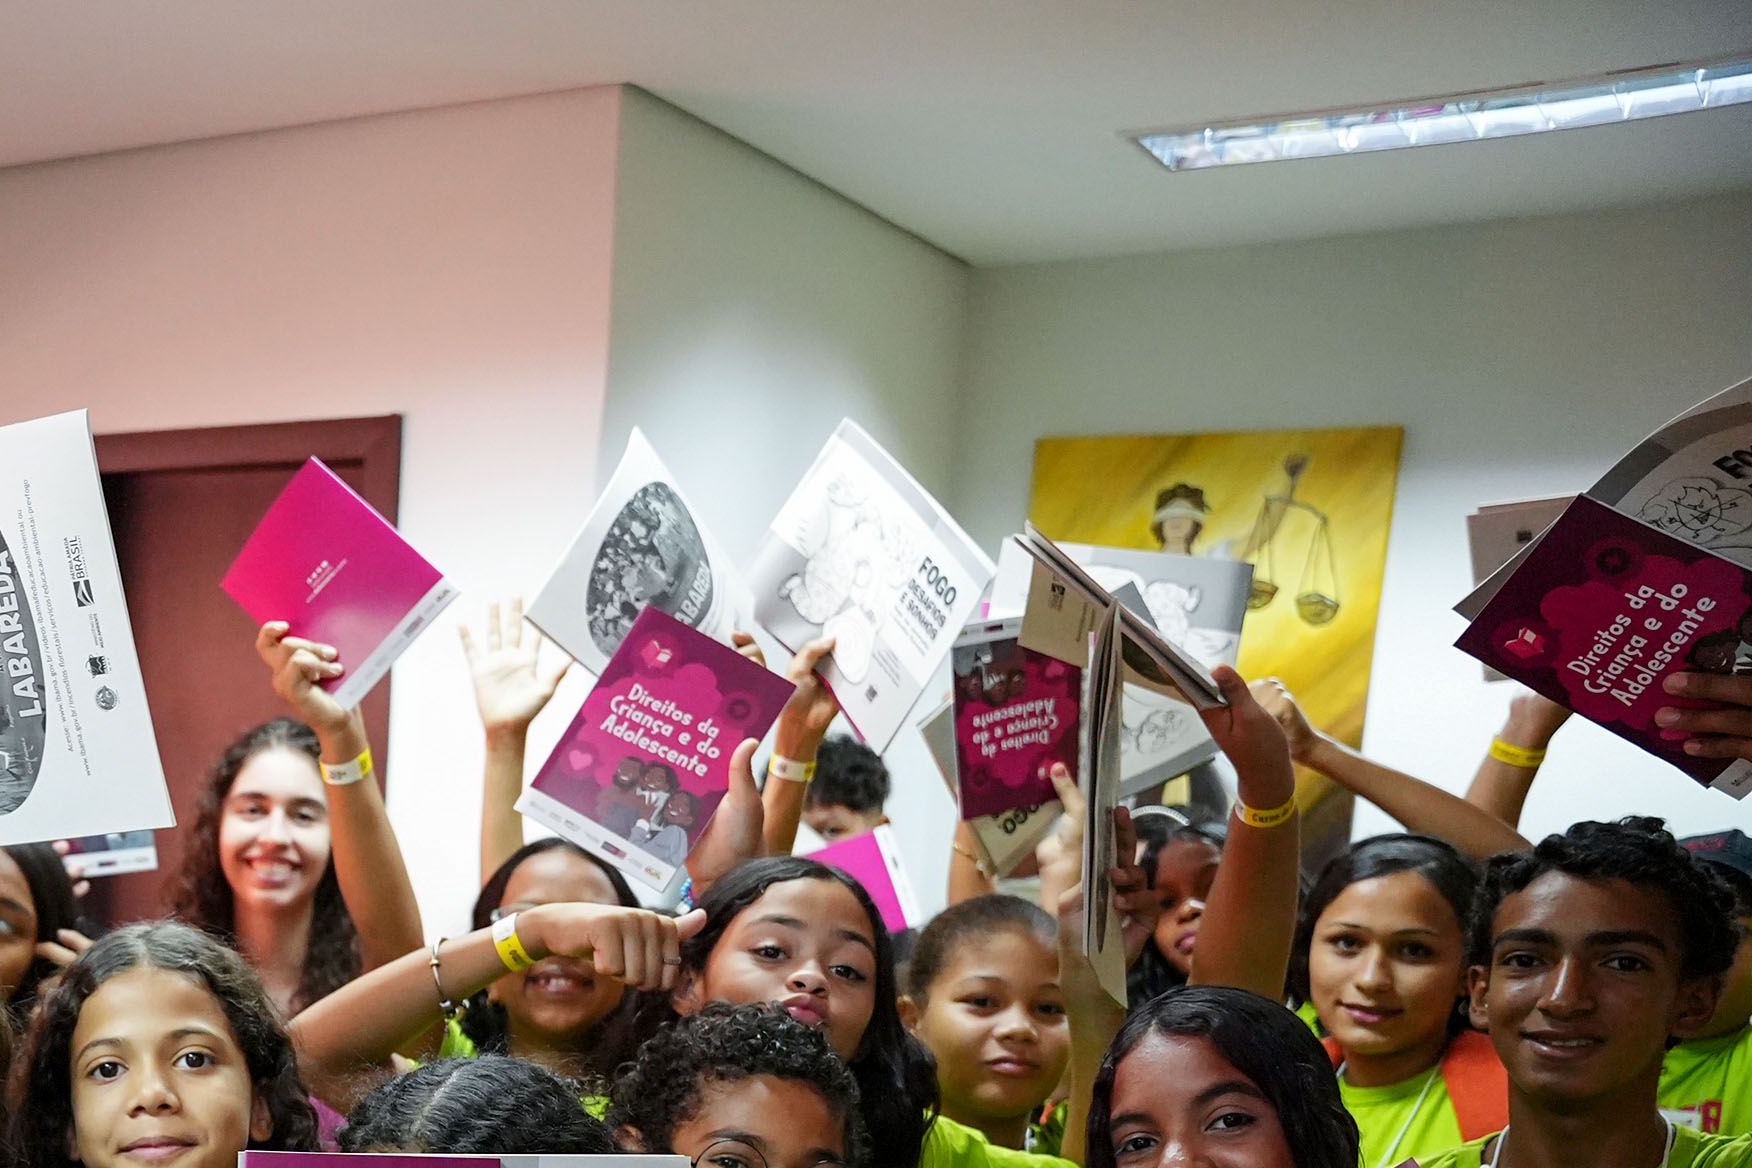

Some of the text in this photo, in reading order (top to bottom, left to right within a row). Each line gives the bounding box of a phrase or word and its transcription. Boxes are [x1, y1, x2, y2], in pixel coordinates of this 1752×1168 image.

[69, 535, 86, 579] BRASIL
[906, 599, 938, 641] SONHOS
[908, 579, 946, 628] DESAFIOS
[1567, 584, 1655, 676] Direitos da
[1583, 582, 1688, 694] Criança e do
[1610, 595, 1716, 707] Adolescente
[609, 695, 721, 759] Criança e do
[627, 683, 720, 739] Direitos da
[600, 714, 708, 777] Adolescente
